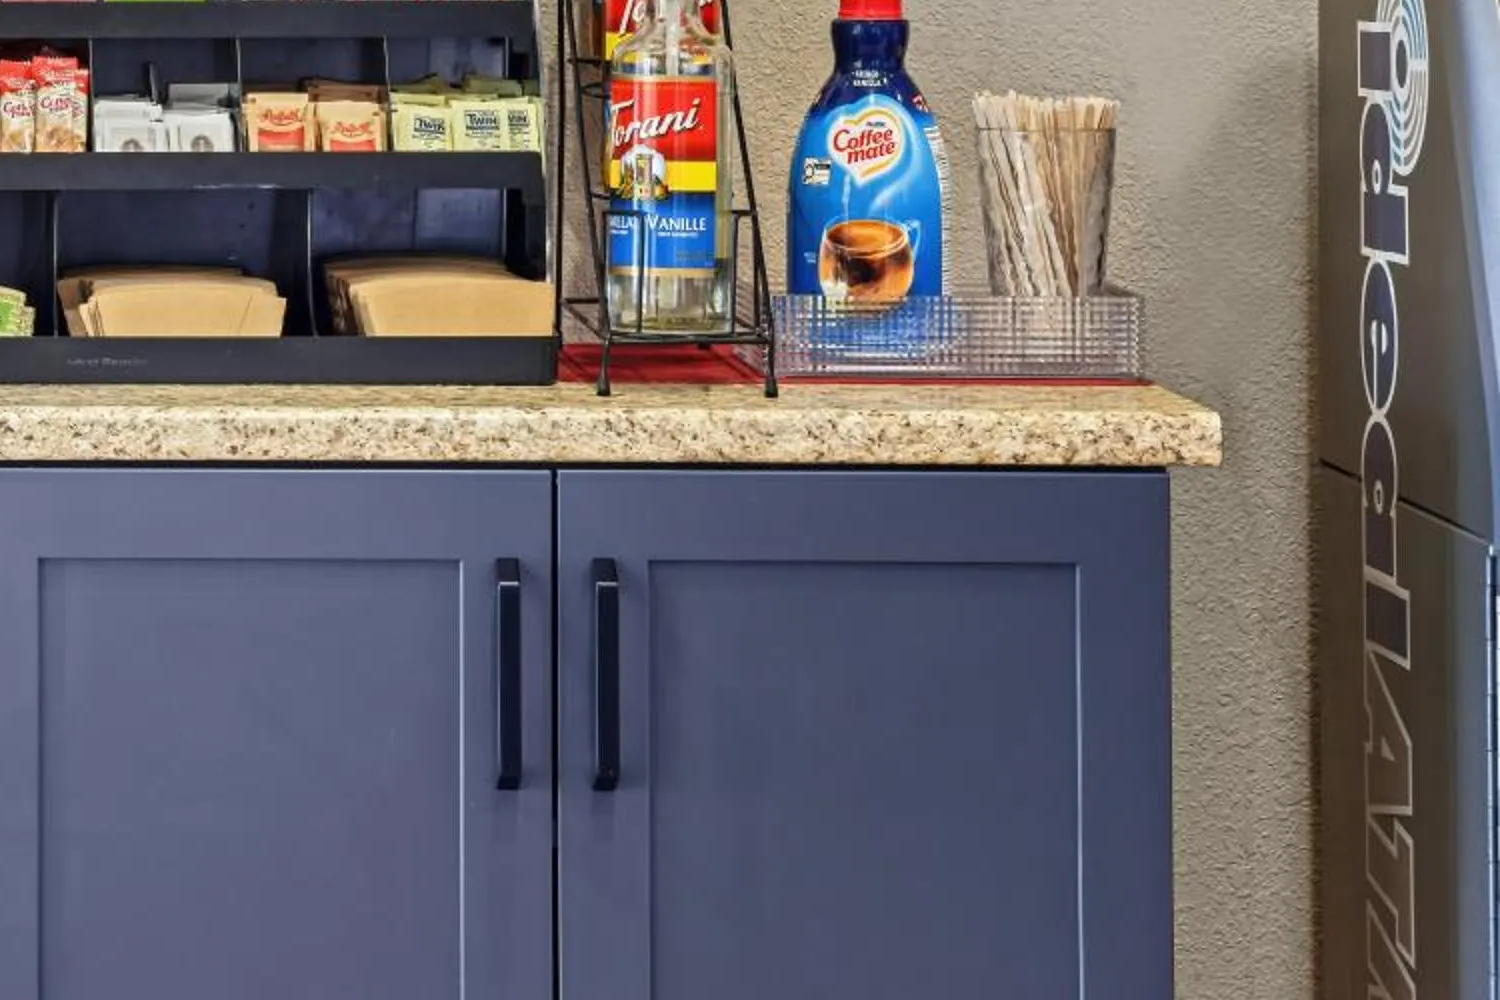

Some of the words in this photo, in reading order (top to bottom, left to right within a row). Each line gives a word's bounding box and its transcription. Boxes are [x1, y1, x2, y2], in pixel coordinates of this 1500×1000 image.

[610, 98, 703, 147] Torani
[833, 128, 894, 152] Coffee
[846, 141, 896, 165] mate
[644, 212, 708, 231] VANILLE
